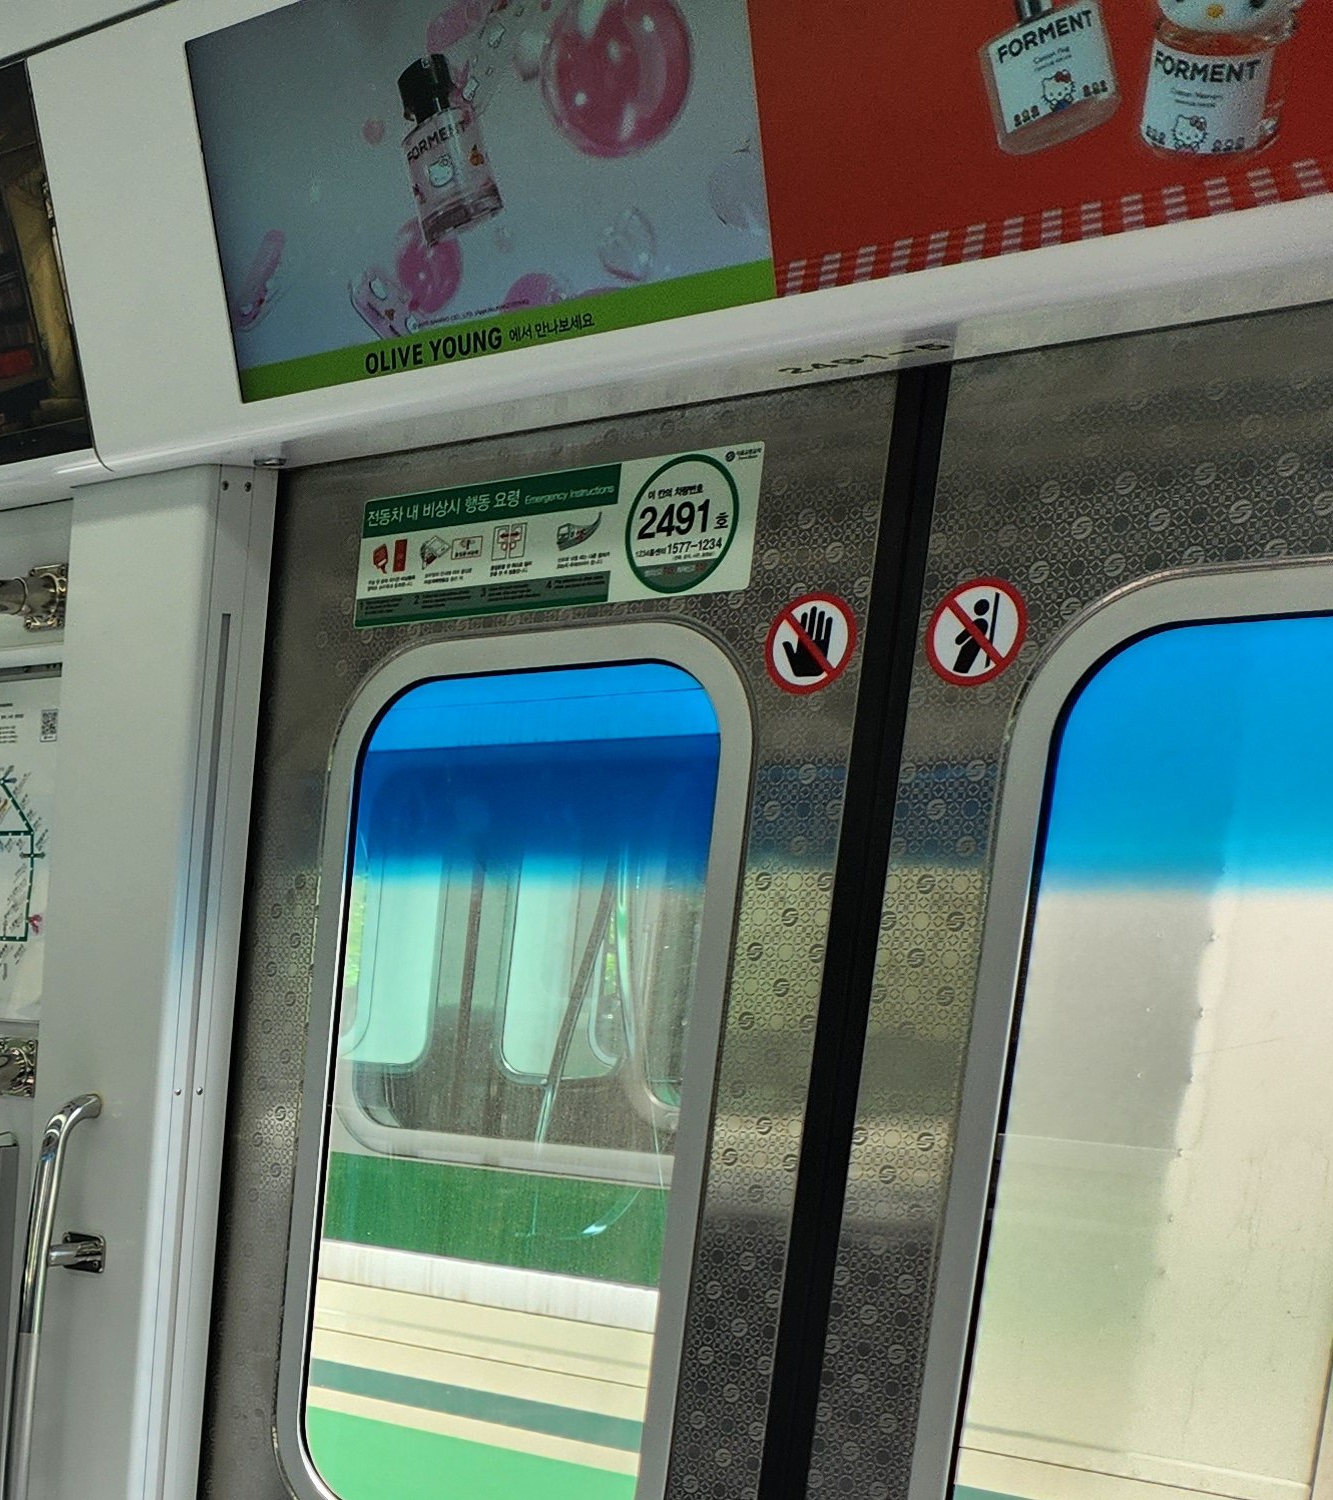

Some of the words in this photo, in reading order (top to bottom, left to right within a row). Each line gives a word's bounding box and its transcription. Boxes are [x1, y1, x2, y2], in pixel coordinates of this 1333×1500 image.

[996, 9, 1093, 64] FORMENT
[1153, 50, 1261, 84] FORMENT
[364, 342, 424, 374] OLIVE
[428, 327, 502, 361] YOUNG
[508, 327, 533, 342] 에서
[535, 313, 595, 338] 만나보세요
[367, 502, 405, 528] 전동차
[406, 498, 419, 518] 내
[422, 494, 462, 520] 비상시
[464, 491, 491, 514] 행동
[493, 488, 522, 511] 요령
[524, 493, 568, 505] Emergency
[637, 498, 711, 541] 2491
[714, 512, 729, 530] 호
[667, 537, 723, 555] 1577-1234
